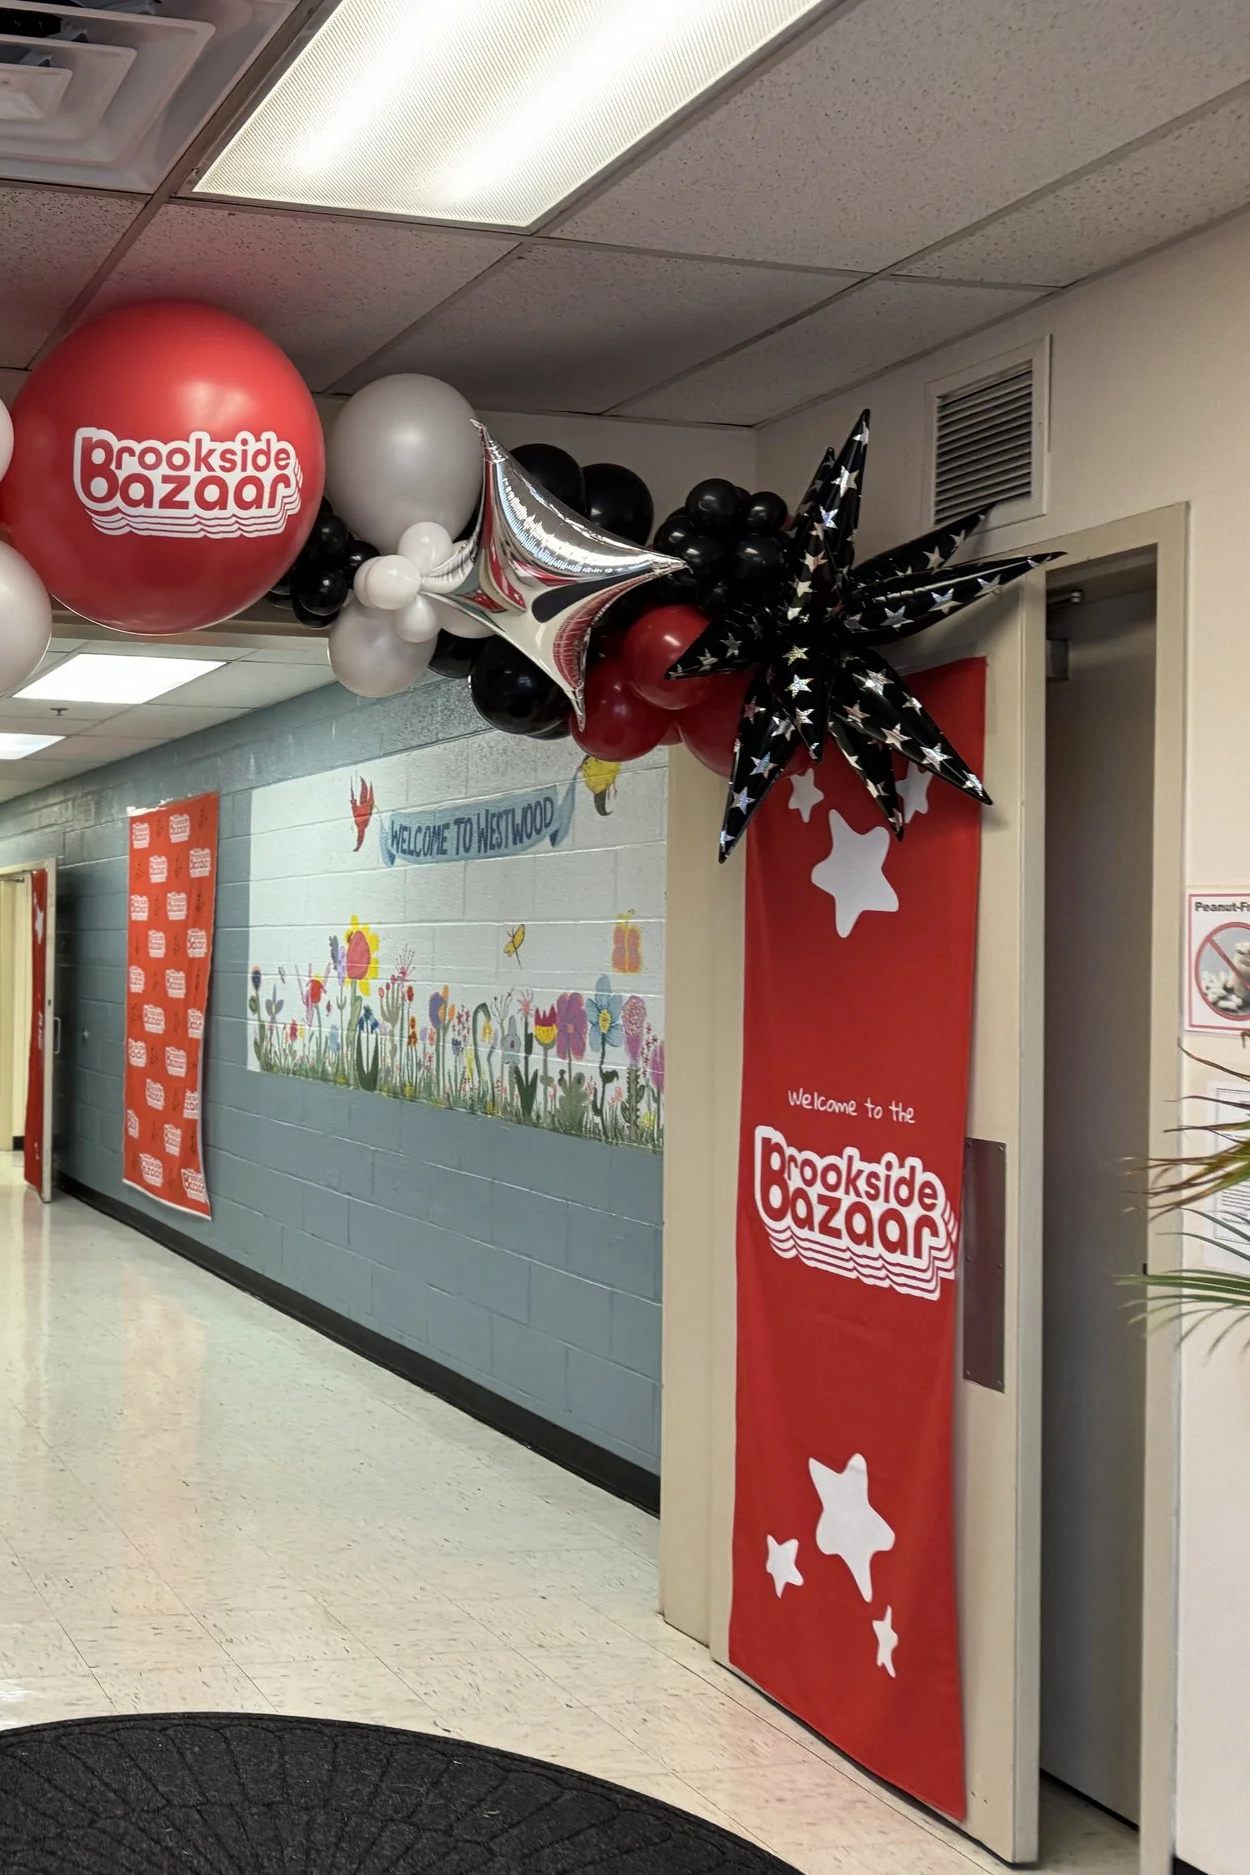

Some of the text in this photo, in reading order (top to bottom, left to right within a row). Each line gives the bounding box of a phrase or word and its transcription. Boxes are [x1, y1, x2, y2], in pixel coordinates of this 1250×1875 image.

[80, 436, 291, 473] Brookside
[80, 470, 291, 511] Bazaar
[391, 796, 554, 858] WELCOME TO WESTWOOD
[788, 1088, 916, 1124] Welcome to the
[760, 1136, 939, 1213] Brookside
[760, 1176, 940, 1260] Bazaar
